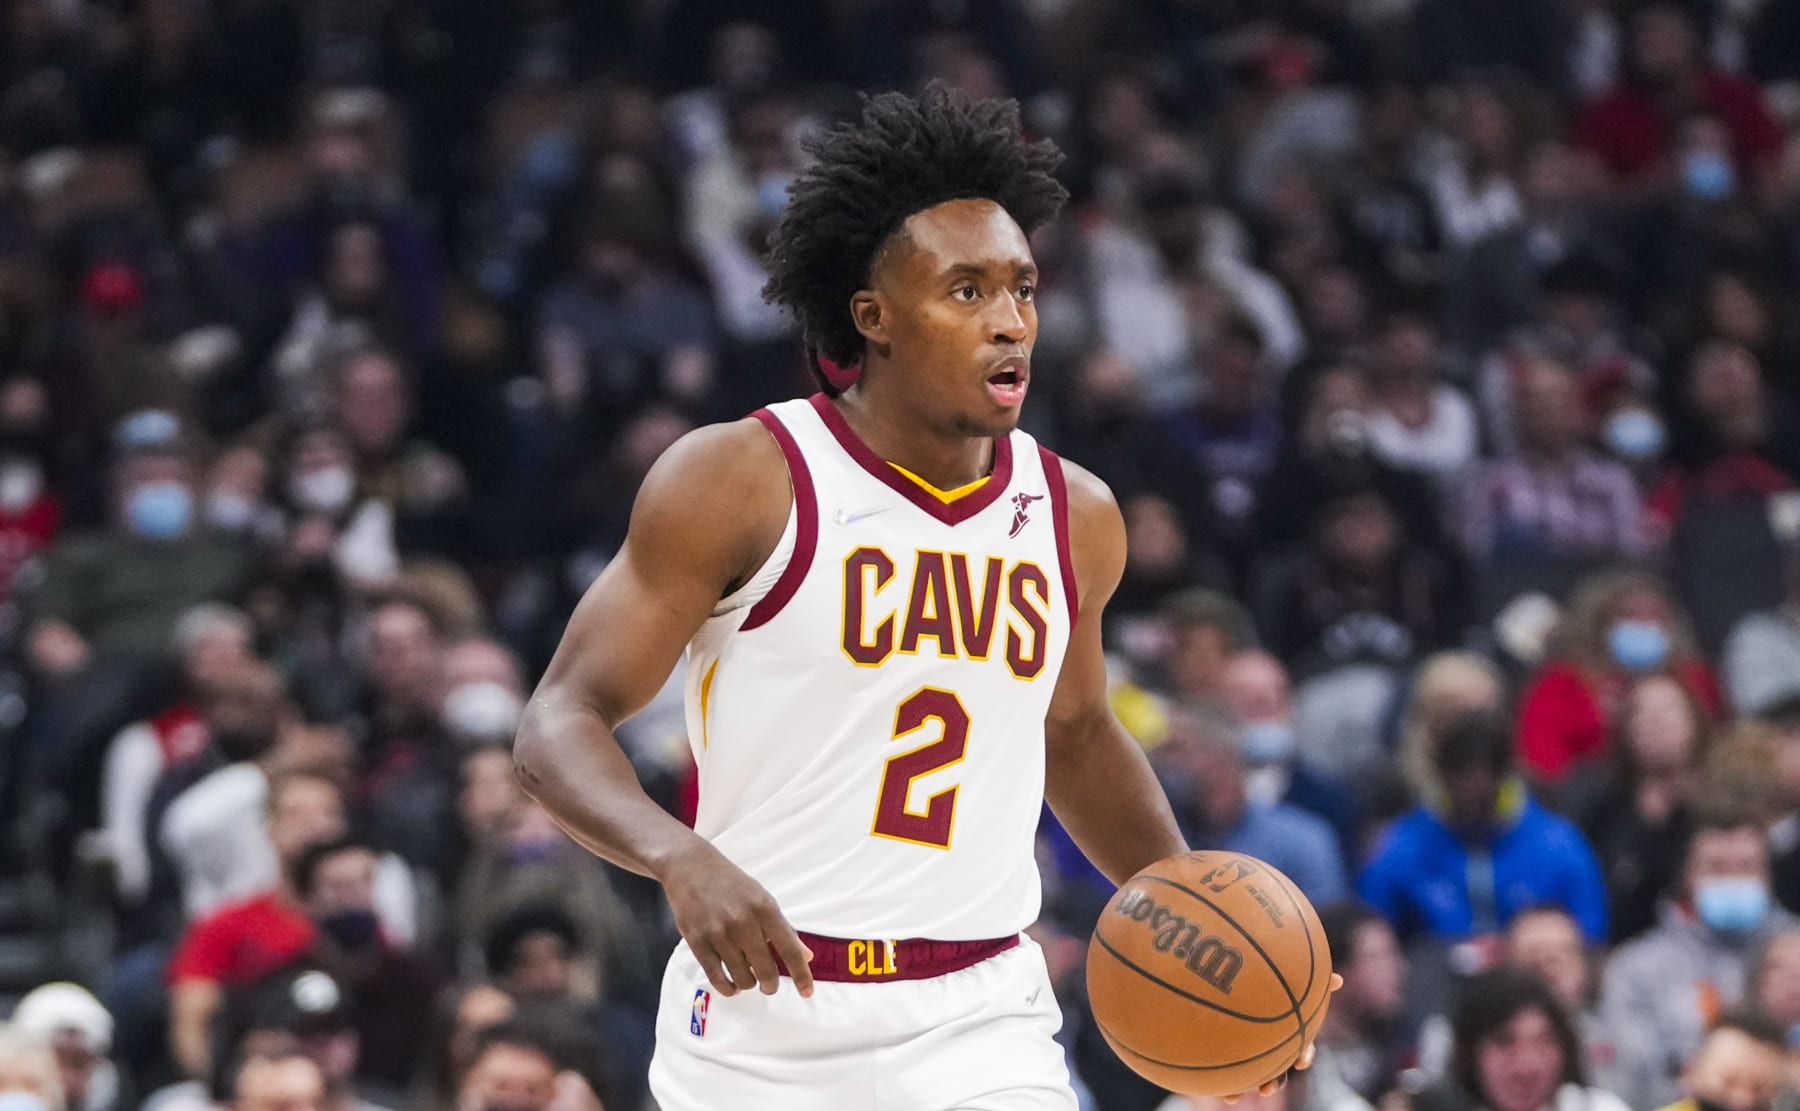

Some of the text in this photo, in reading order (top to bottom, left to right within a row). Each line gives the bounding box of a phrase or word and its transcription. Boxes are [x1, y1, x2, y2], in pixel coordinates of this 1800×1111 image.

[841, 544, 1049, 681] CAVS
[870, 685, 972, 850] 2
[1116, 888, 1243, 996] Wilson
